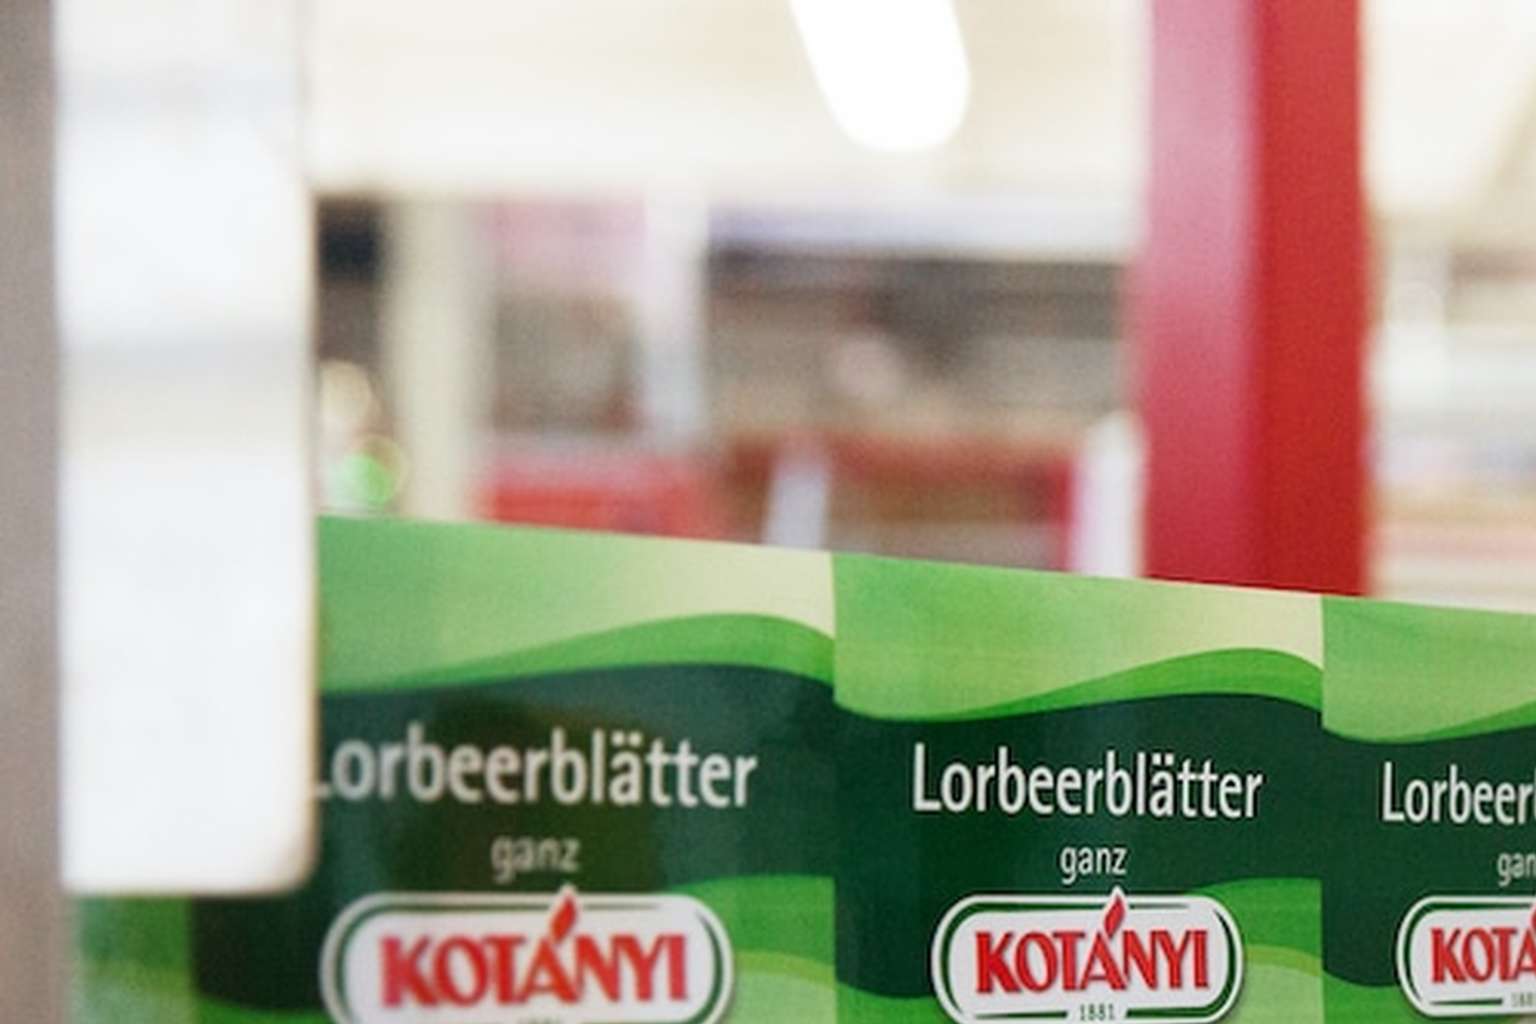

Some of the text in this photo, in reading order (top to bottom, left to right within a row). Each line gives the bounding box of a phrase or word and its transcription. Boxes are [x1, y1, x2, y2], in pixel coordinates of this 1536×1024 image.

[316, 718, 758, 808] orbeerblätter
[913, 742, 1263, 819] Lorbeerblätter
[491, 836, 582, 884] ganz
[1060, 846, 1127, 884] ganz
[379, 895, 690, 1009] KOTÁNYI
[975, 896, 1209, 994] KOTÁNYI
[1079, 1005, 1116, 1021] 1881
